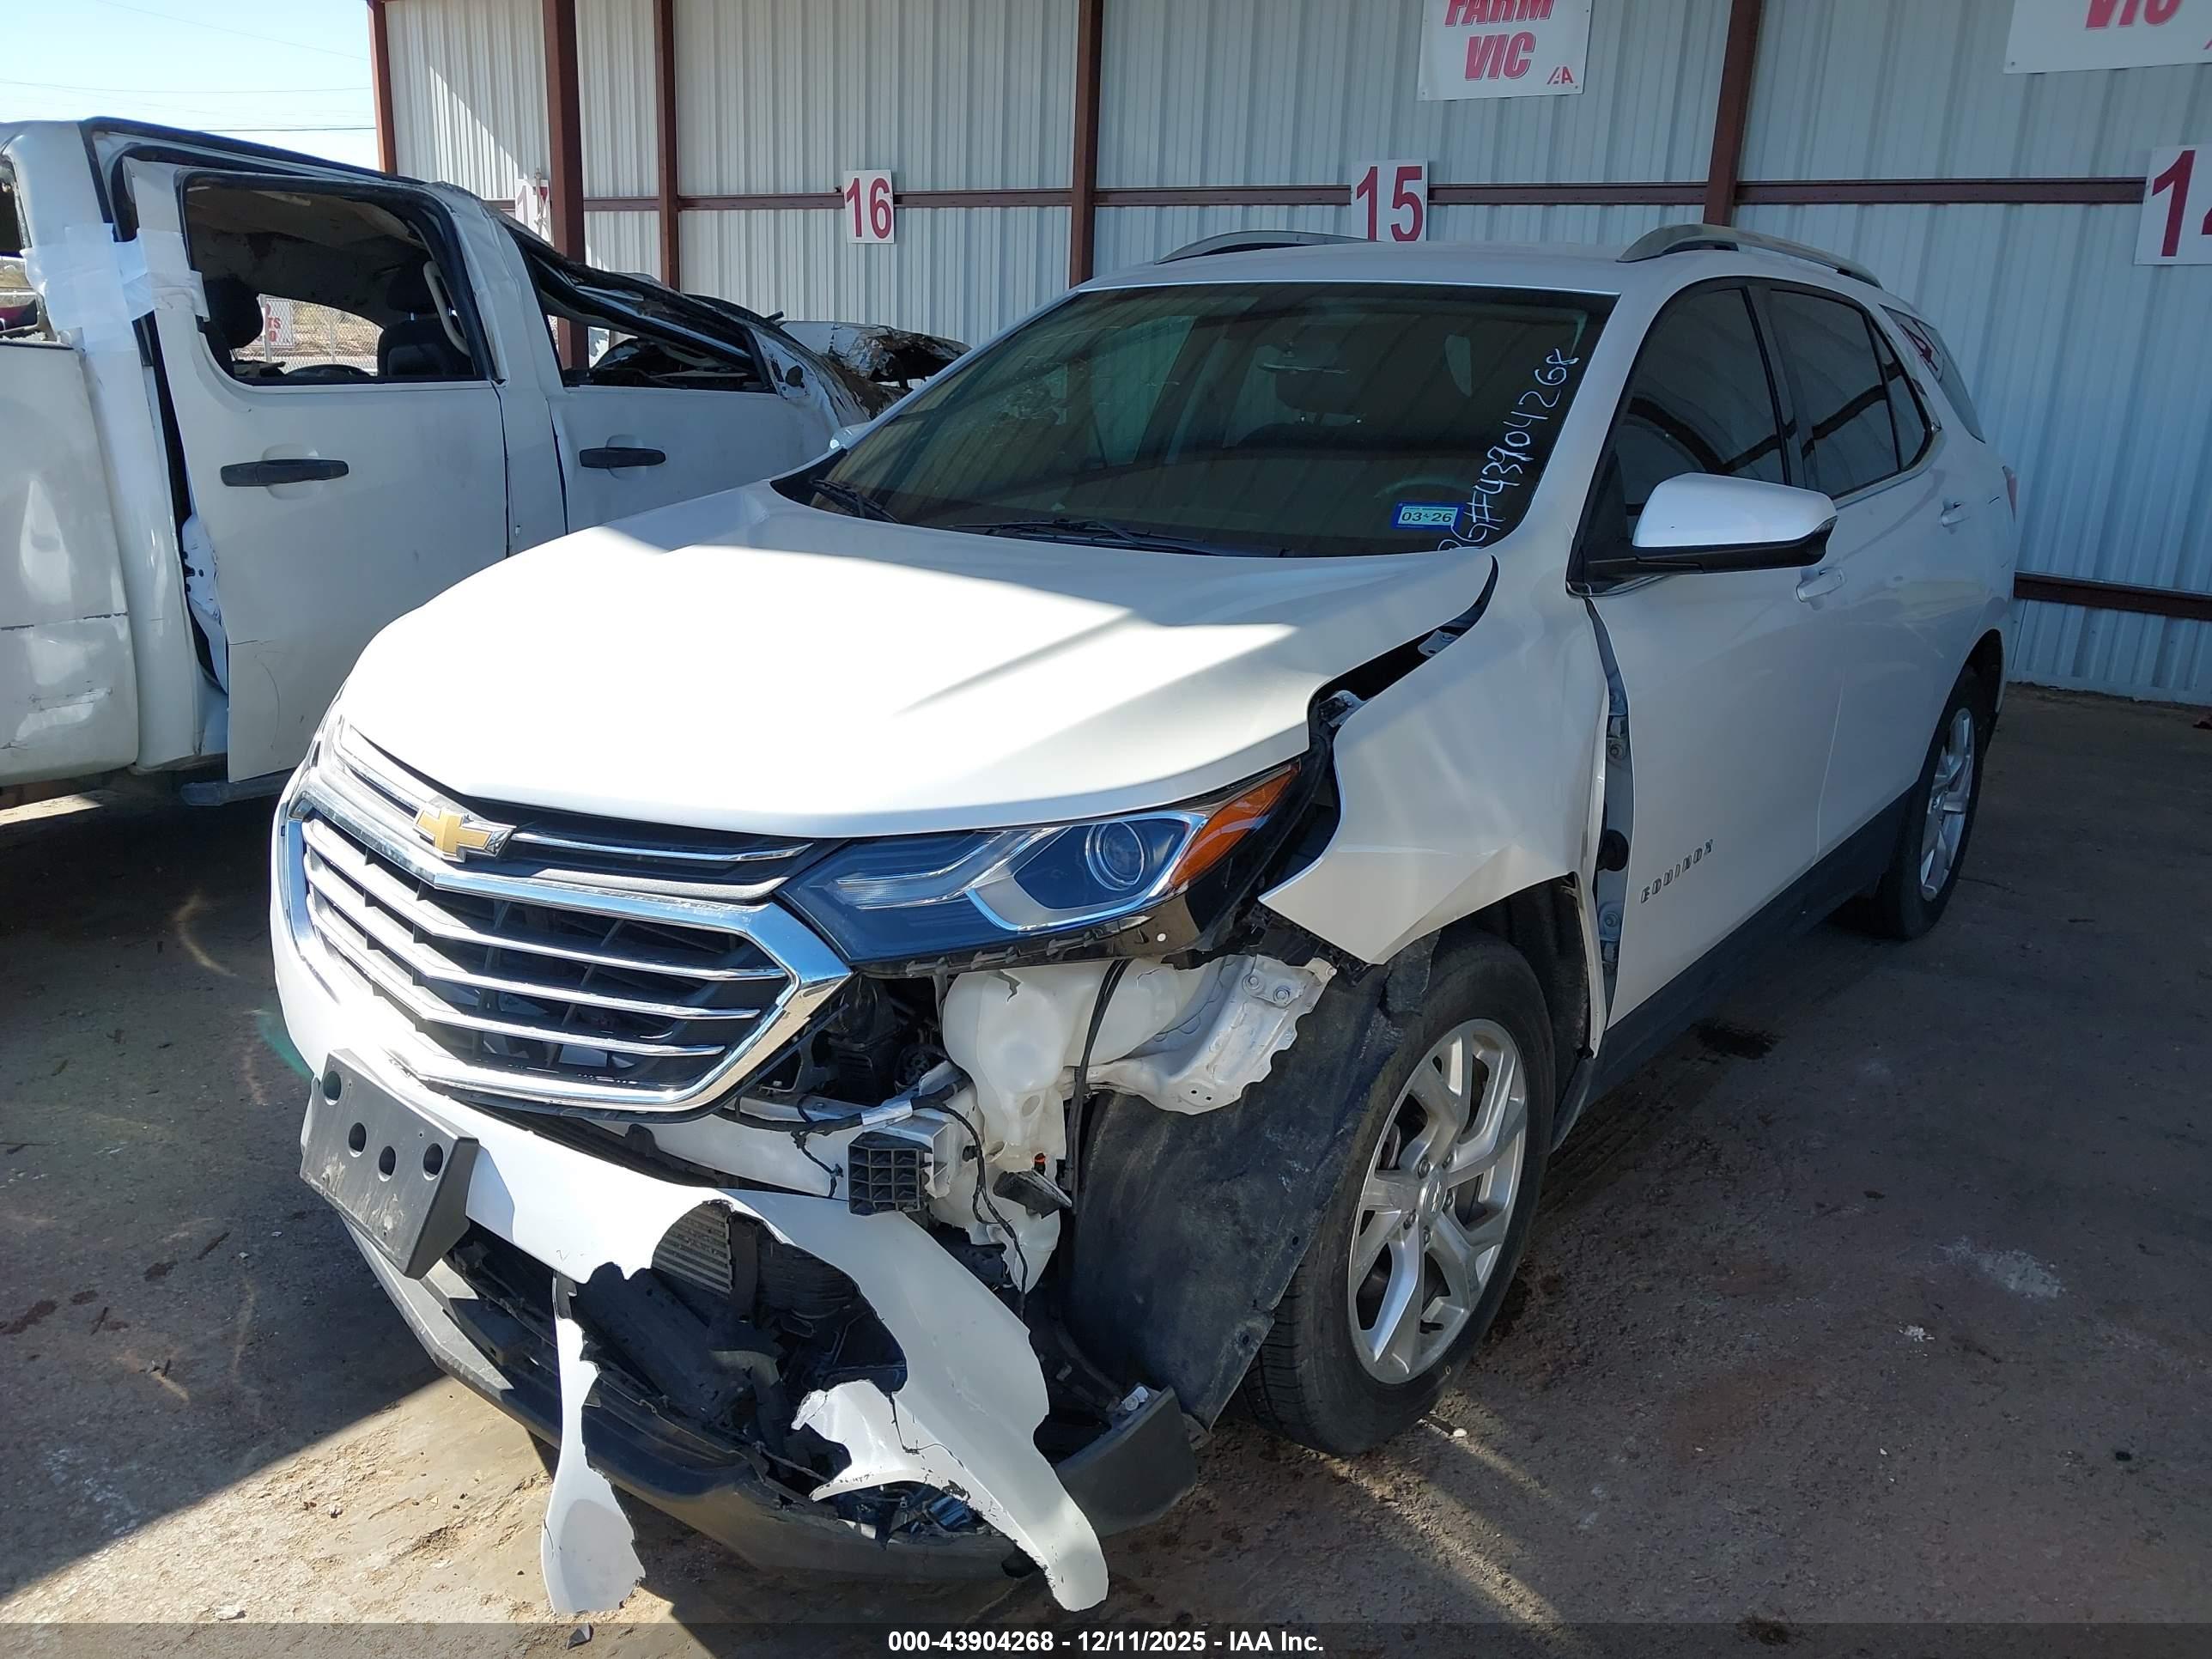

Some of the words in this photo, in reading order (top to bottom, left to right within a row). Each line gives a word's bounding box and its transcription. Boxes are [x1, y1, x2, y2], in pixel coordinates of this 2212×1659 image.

[1465, 31, 1537, 81] VIC
[846, 177, 892, 240] 16
[1356, 165, 1424, 241] 15
[2151, 149, 2212, 257] 1
[1640, 838, 1714, 904] EQUINOX
